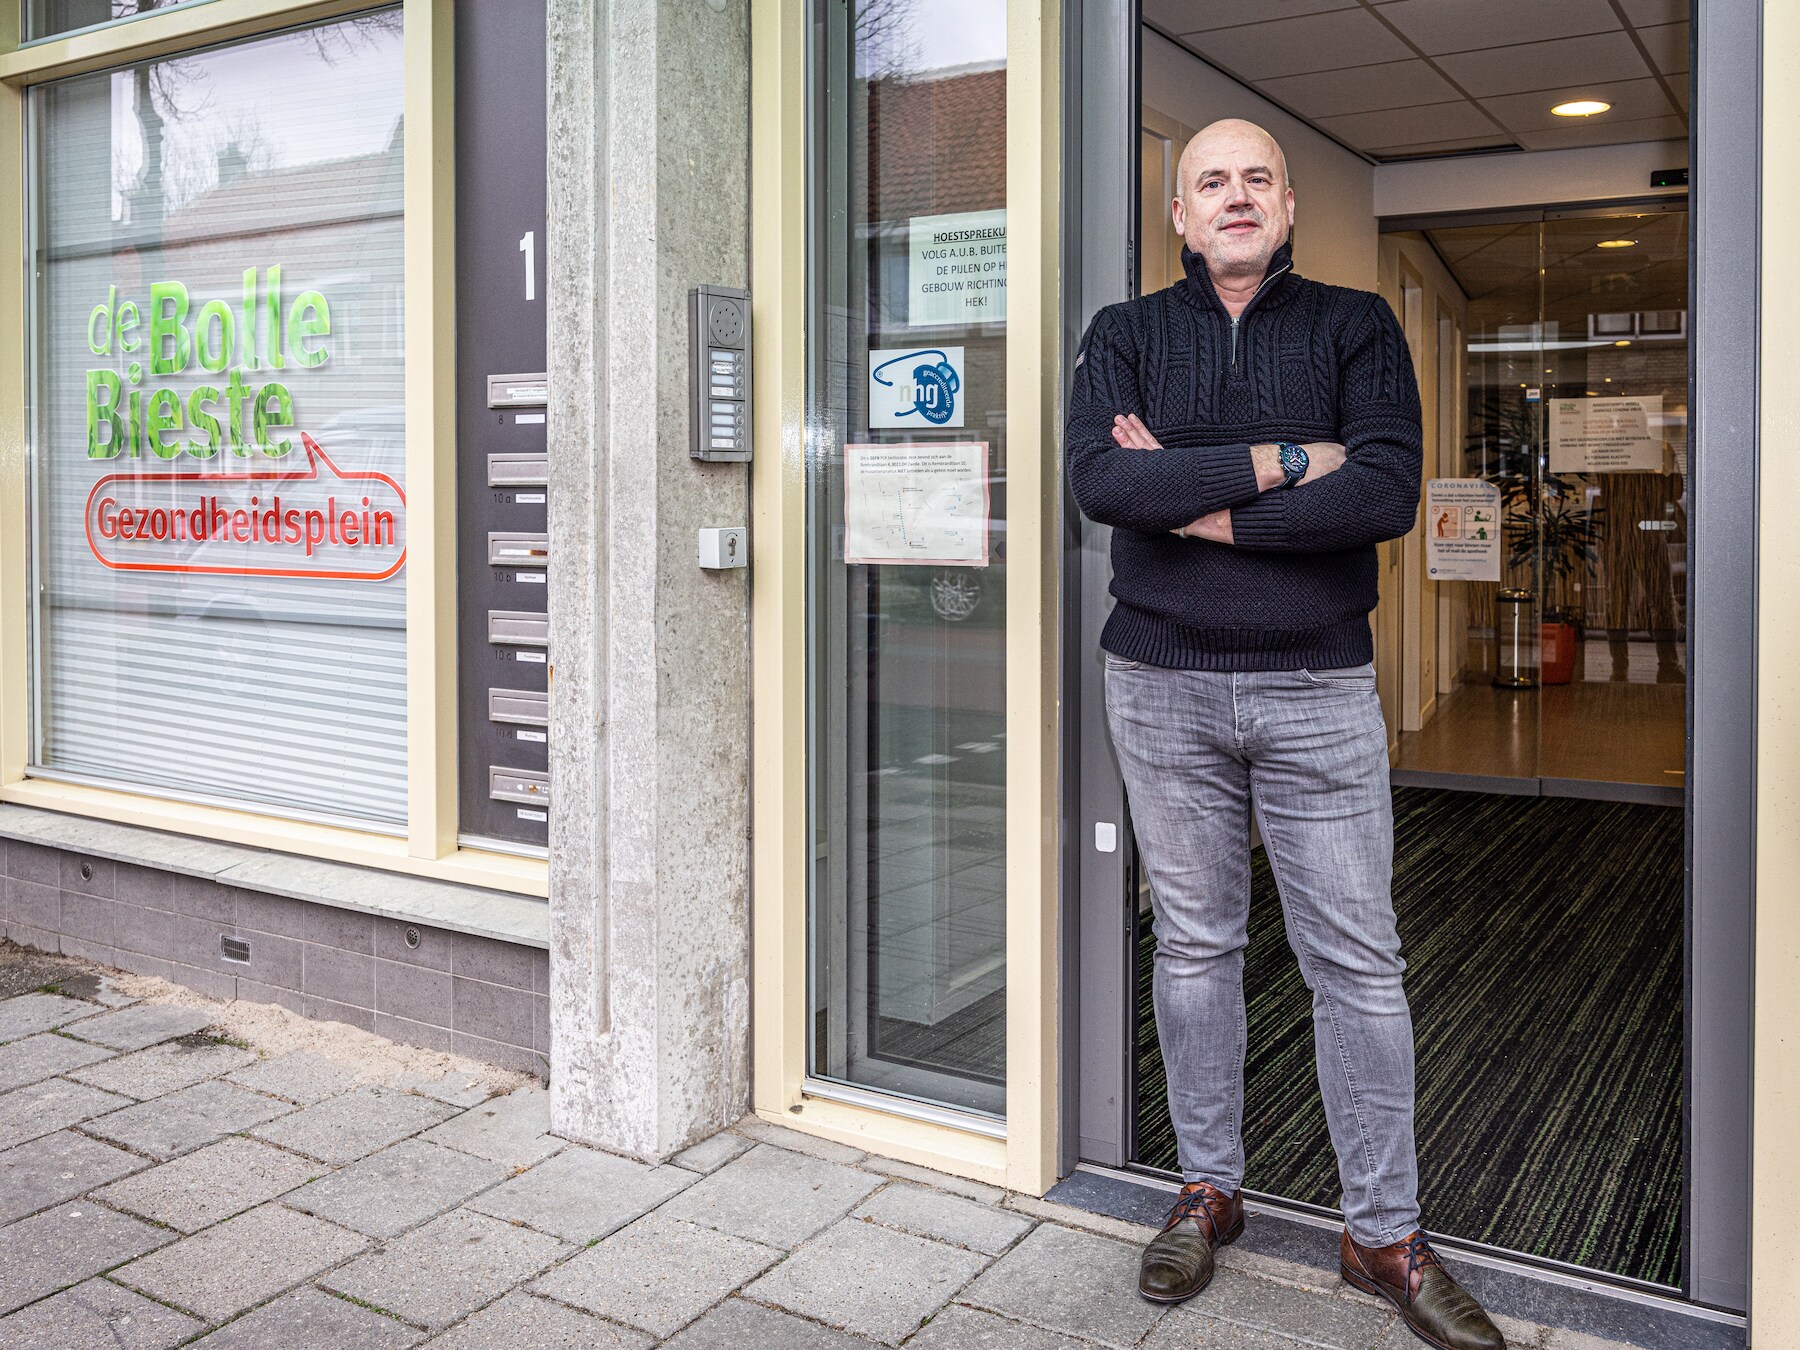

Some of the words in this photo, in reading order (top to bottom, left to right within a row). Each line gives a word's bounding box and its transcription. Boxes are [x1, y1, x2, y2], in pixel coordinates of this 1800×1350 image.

[922, 250, 946, 260] VOLG
[949, 248, 978, 258] A.U.B.
[519, 230, 535, 301] 1
[936, 266, 948, 275] DE
[952, 264, 980, 274] PIJLEN
[984, 262, 996, 272] OP
[999, 262, 1006, 270] H
[922, 282, 964, 293] GEBOUW
[966, 297, 987, 307] HEK!
[88, 284, 141, 356] de
[150, 263, 331, 376] Bolle
[899, 378, 938, 409] nhg
[86, 362, 294, 460] Bieste
[498, 414, 503, 424] 8
[494, 494, 503, 503] 10
[98, 496, 394, 557] Gezondheidsplein
[494, 572, 504, 582] 10
[495, 650, 504, 660] 10
